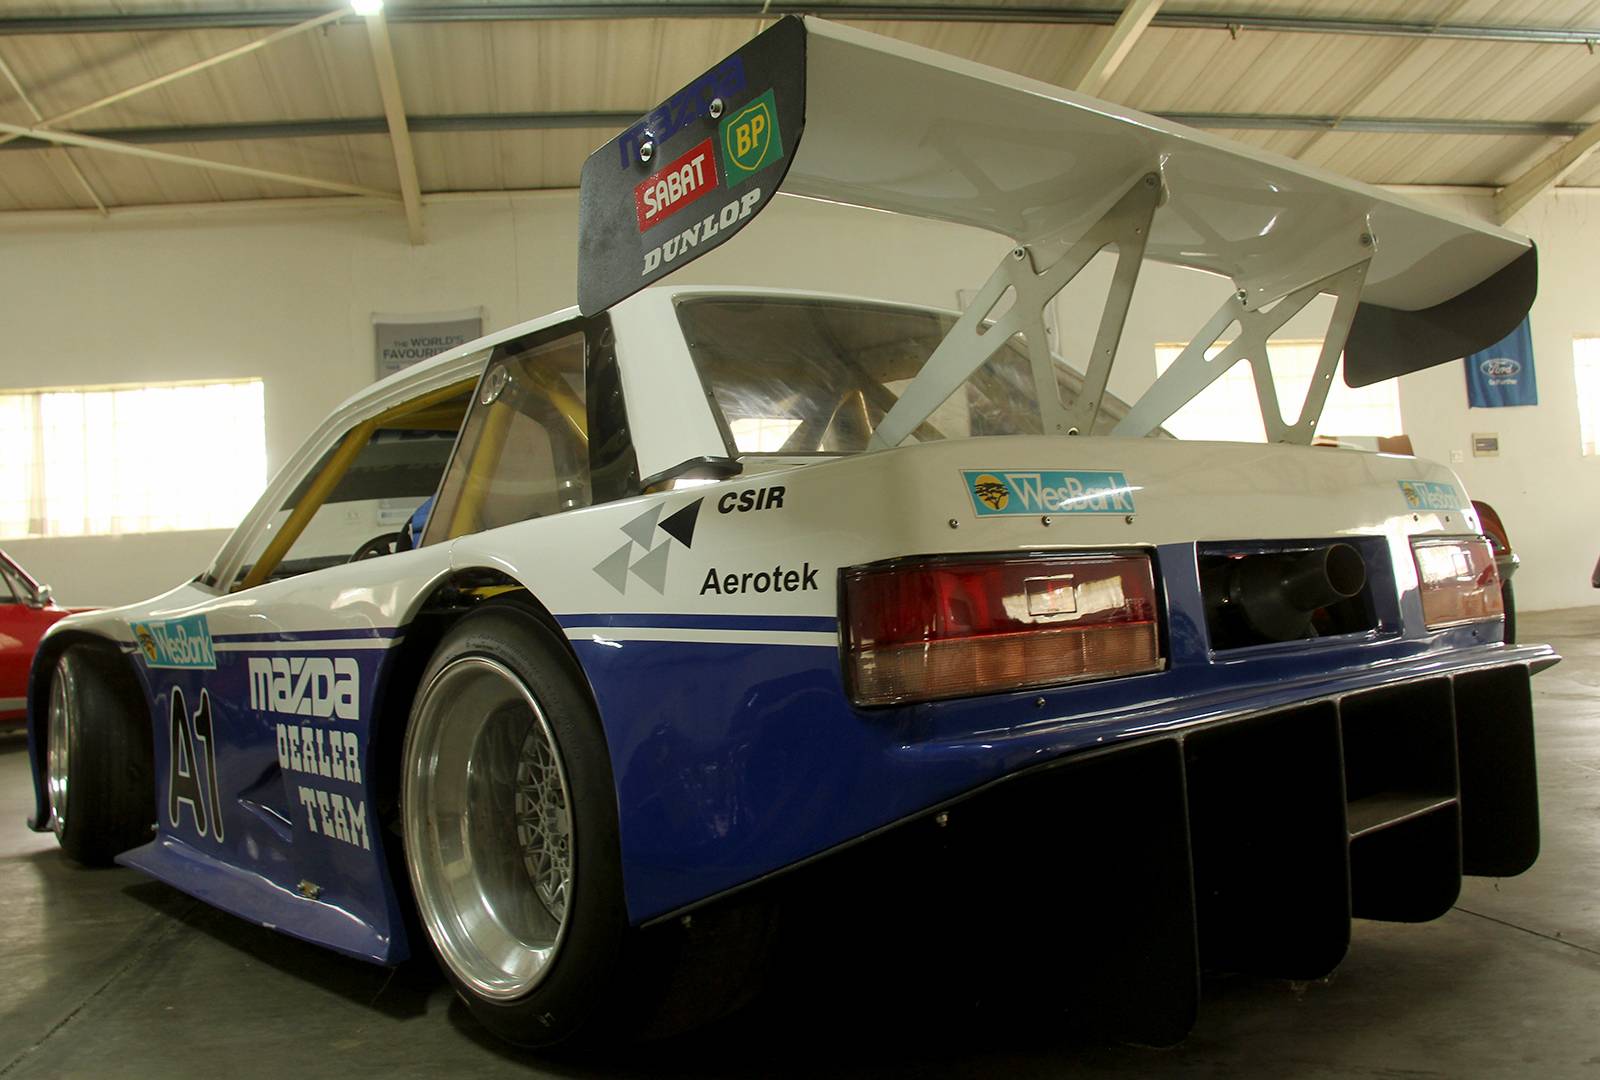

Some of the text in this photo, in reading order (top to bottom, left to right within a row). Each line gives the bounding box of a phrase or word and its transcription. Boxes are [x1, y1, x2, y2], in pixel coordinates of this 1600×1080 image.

[736, 114, 765, 158] BP
[643, 154, 706, 220] SABAT
[641, 187, 761, 276] DUNLOP
[410, 335, 464, 347] WORLD'S
[717, 486, 786, 514] CSIR
[1003, 473, 1133, 511] WesBank
[699, 563, 819, 595] Aerotek
[150, 618, 214, 665] WesBank
[168, 685, 224, 843] A1
[276, 723, 362, 784] DEALER
[298, 786, 370, 851] TEAM
